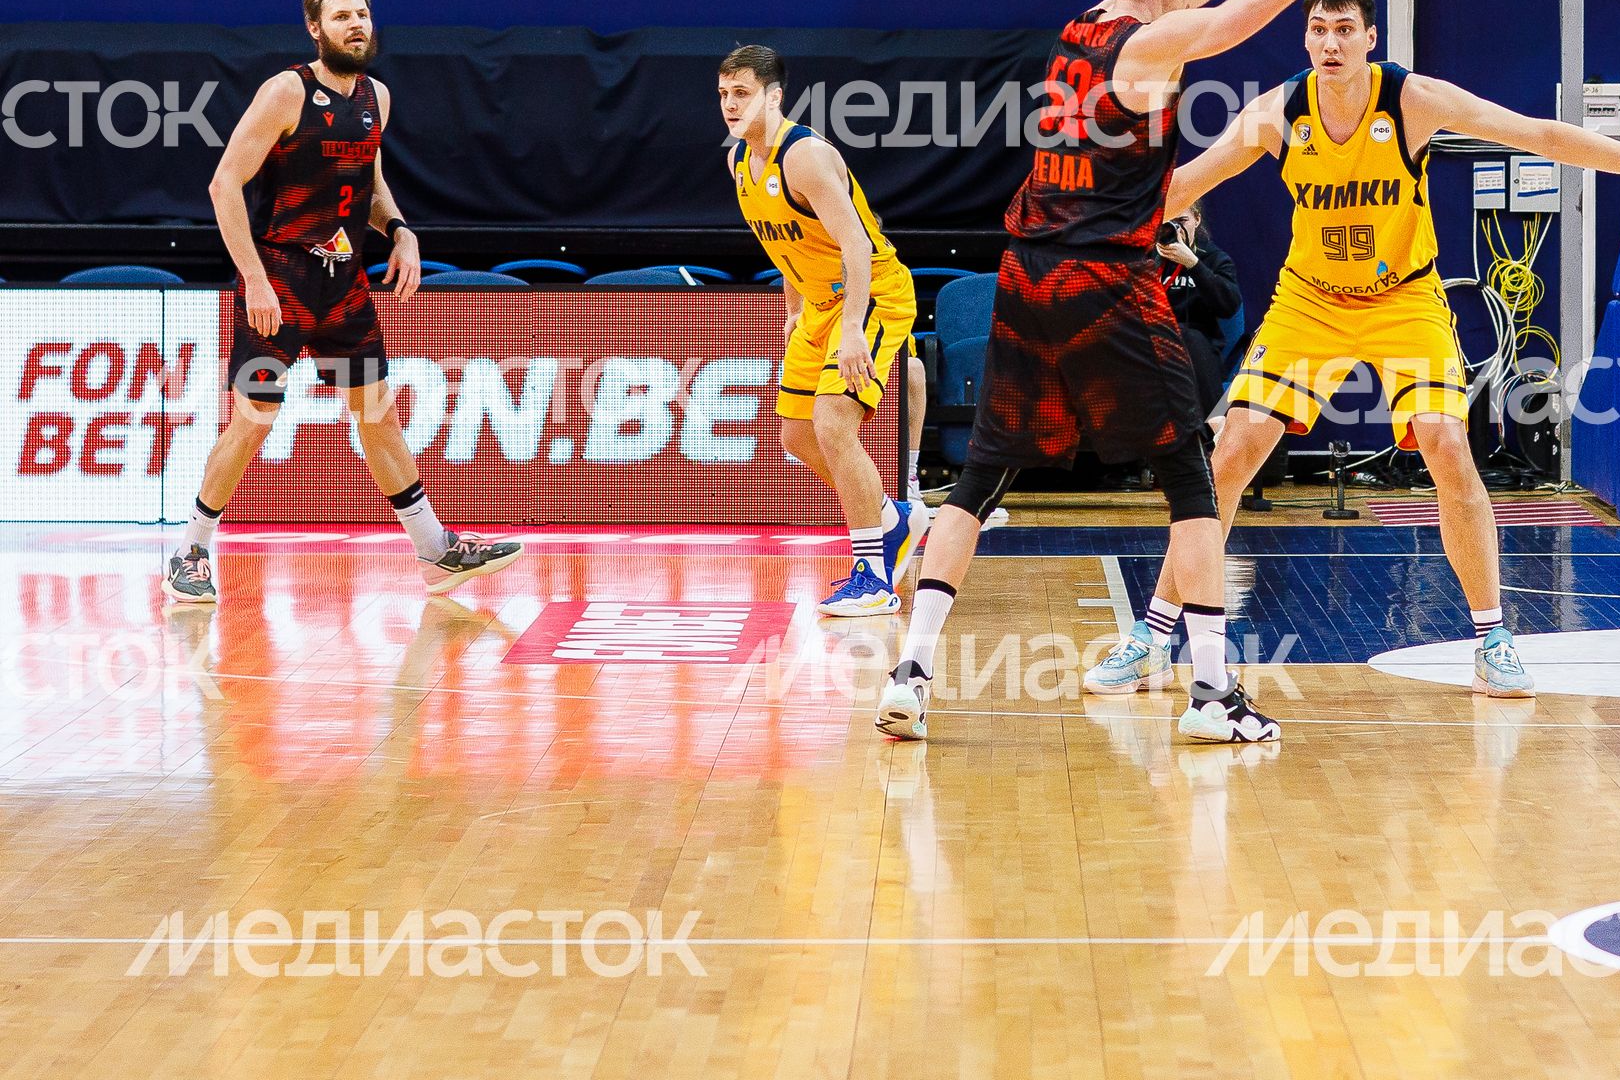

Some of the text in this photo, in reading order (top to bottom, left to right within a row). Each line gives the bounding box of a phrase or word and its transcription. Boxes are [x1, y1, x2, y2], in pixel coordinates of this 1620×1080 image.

[1373, 126, 1390, 134] РФБ
[1034, 151, 1094, 192] ЕВДА
[338, 185, 353, 217] 2
[1295, 178, 1401, 210] ХИМКИ
[747, 219, 804, 242] ИМКИ
[1322, 224, 1375, 262] 99
[16, 341, 197, 401] FON
[261, 356, 804, 465] FON.BE
[16, 410, 197, 477] BET
[551, 602, 753, 662] FONBET
